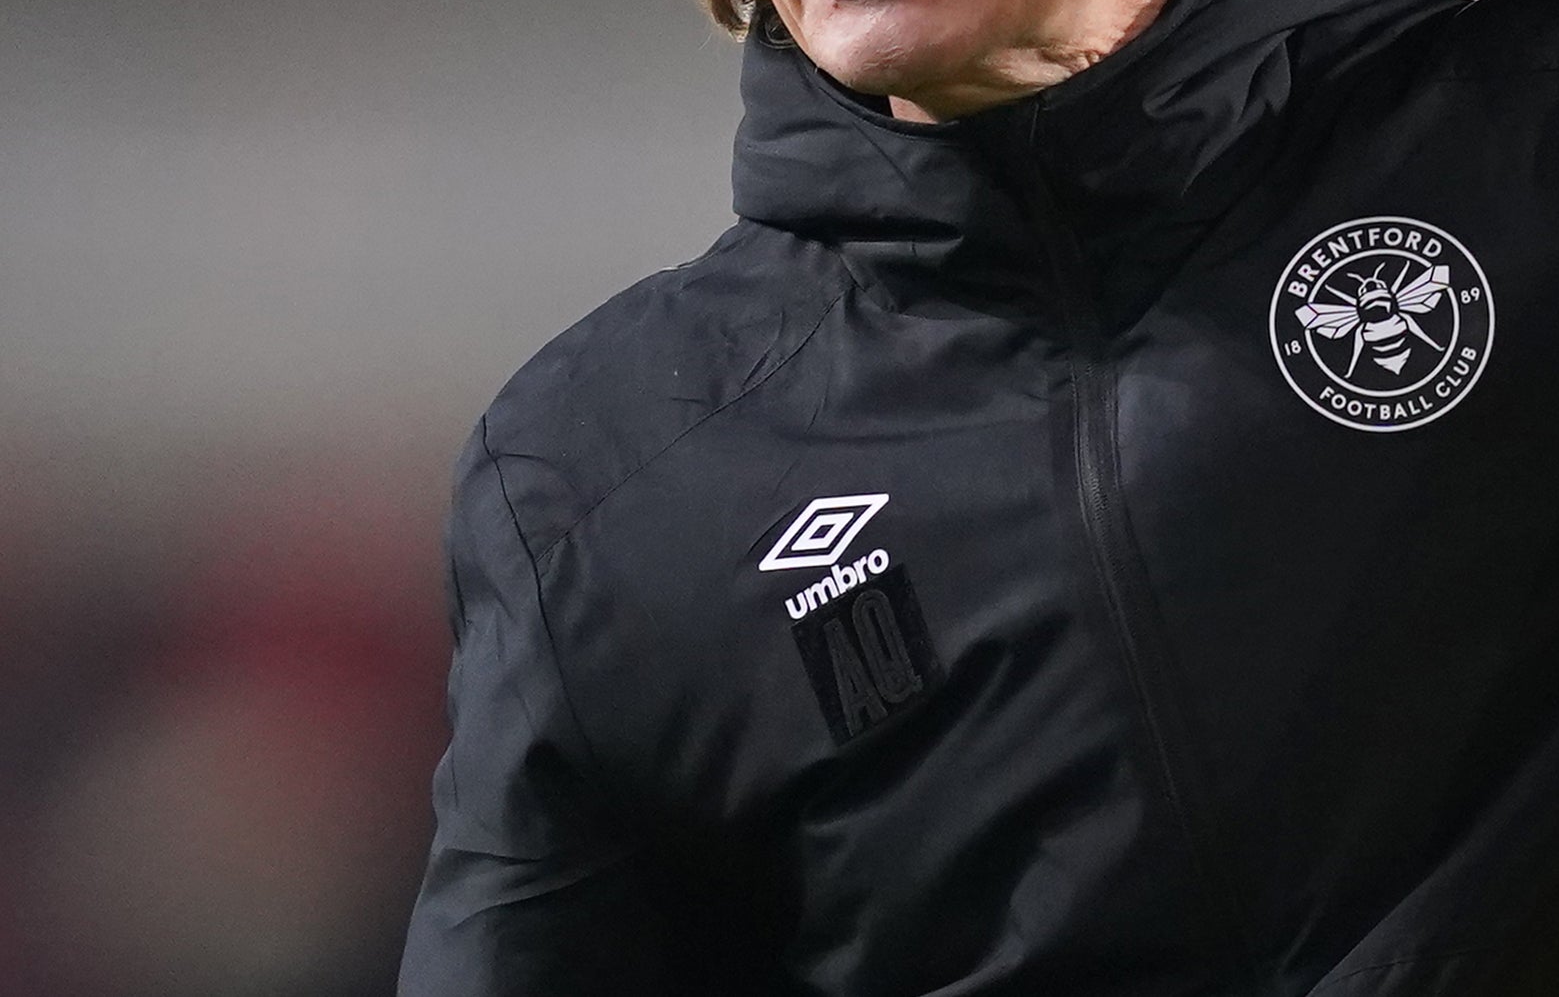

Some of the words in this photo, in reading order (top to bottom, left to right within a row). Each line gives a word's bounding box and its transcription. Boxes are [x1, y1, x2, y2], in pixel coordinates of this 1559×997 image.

[1288, 228, 1442, 298] BRENTFORD
[1460, 287, 1481, 304] 89
[1284, 340, 1302, 356] 18
[1319, 386, 1433, 420] FOOTBALL
[1435, 346, 1477, 397] CLUB
[785, 549, 889, 620] umbro
